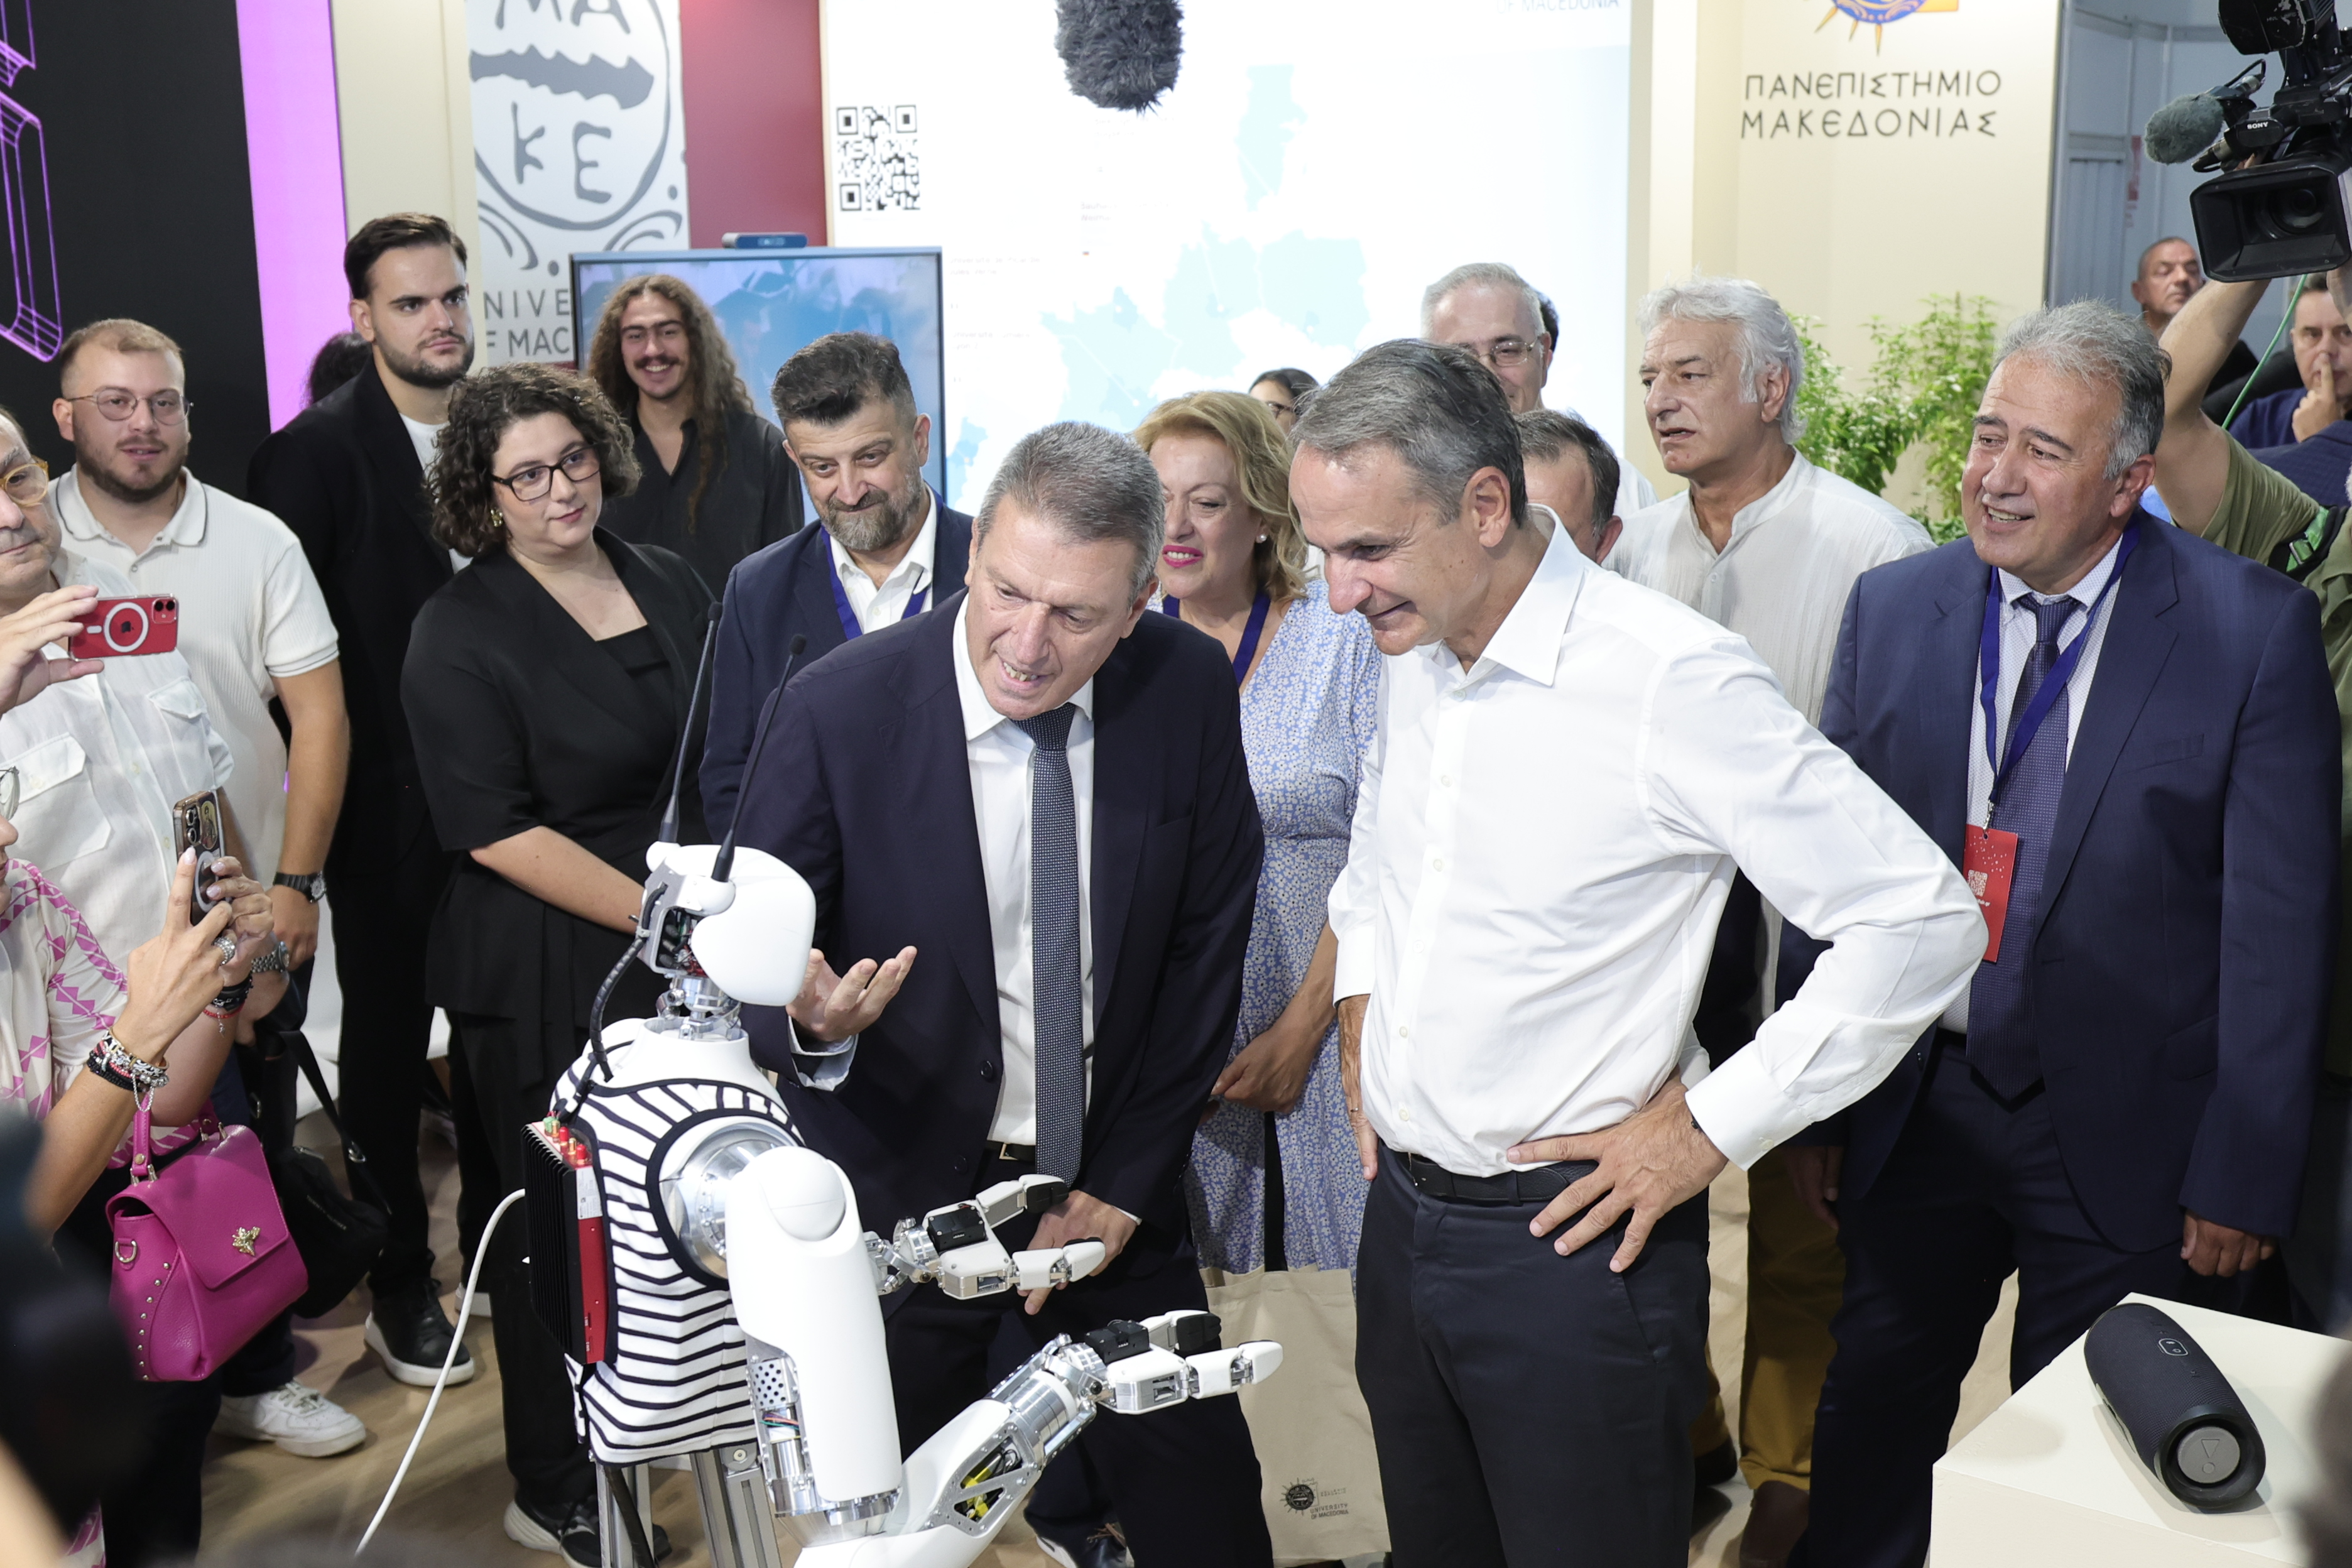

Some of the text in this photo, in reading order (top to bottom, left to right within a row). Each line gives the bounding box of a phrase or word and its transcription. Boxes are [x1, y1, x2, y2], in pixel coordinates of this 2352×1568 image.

[1745, 69, 2002, 101] ΠΑΝΕΠΙΣΤΗΜΙΟ
[1741, 107, 1998, 139] ΜΑΚΕΔΟΝΙΑΣ
[2246, 121, 2269, 130] SONY
[483, 288, 570, 319] NIVE
[508, 326, 570, 357] MAC
[1310, 1503, 1348, 1514] UNIVERSITY
